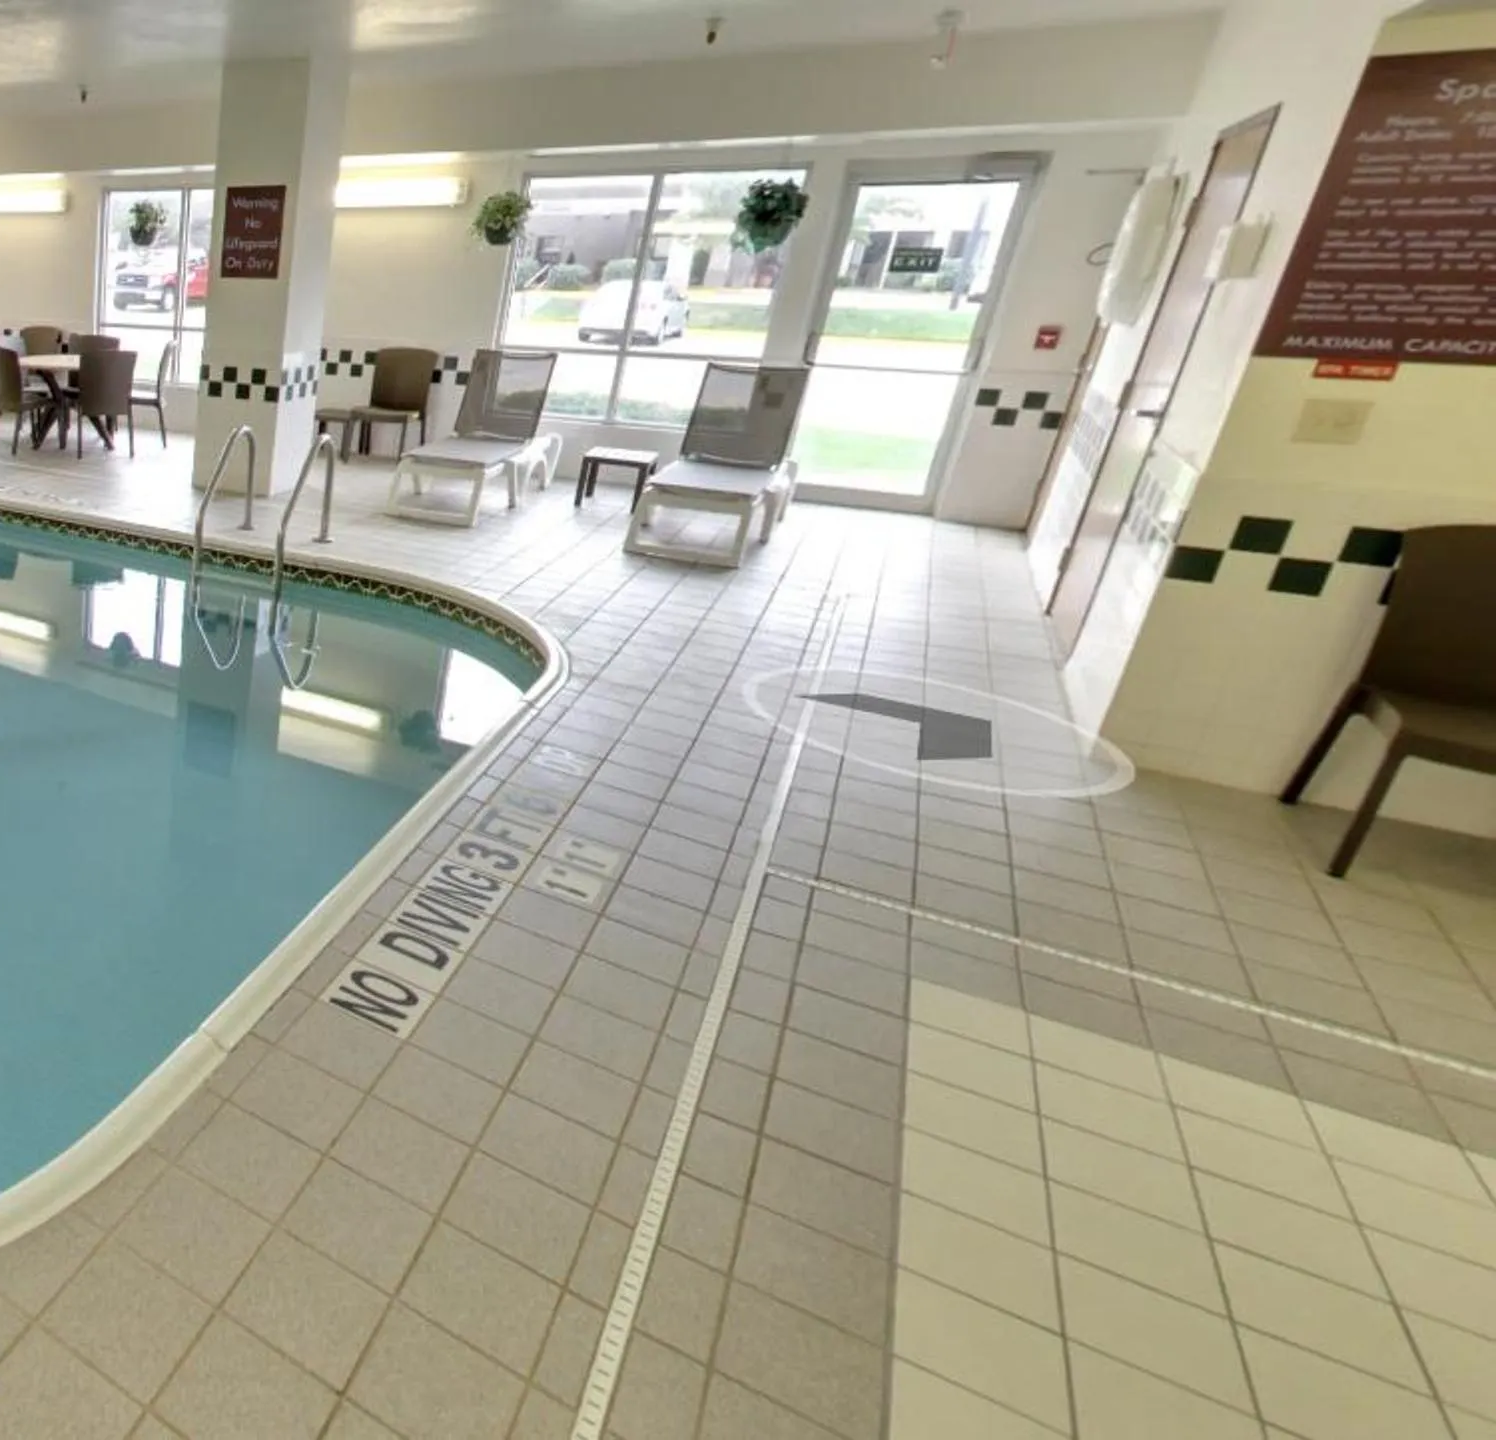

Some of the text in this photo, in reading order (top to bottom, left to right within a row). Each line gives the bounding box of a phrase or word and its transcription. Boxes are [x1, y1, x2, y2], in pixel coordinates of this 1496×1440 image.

[232, 197, 279, 212] Warning
[245, 217, 261, 229] No
[225, 238, 278, 251] Lifeguard
[225, 257, 274, 272] On Duty
[894, 257, 936, 267] EXIT
[1285, 336, 1396, 350] MAXIMUM
[329, 969, 419, 1033] NO
[378, 865, 501, 971] DIVING
